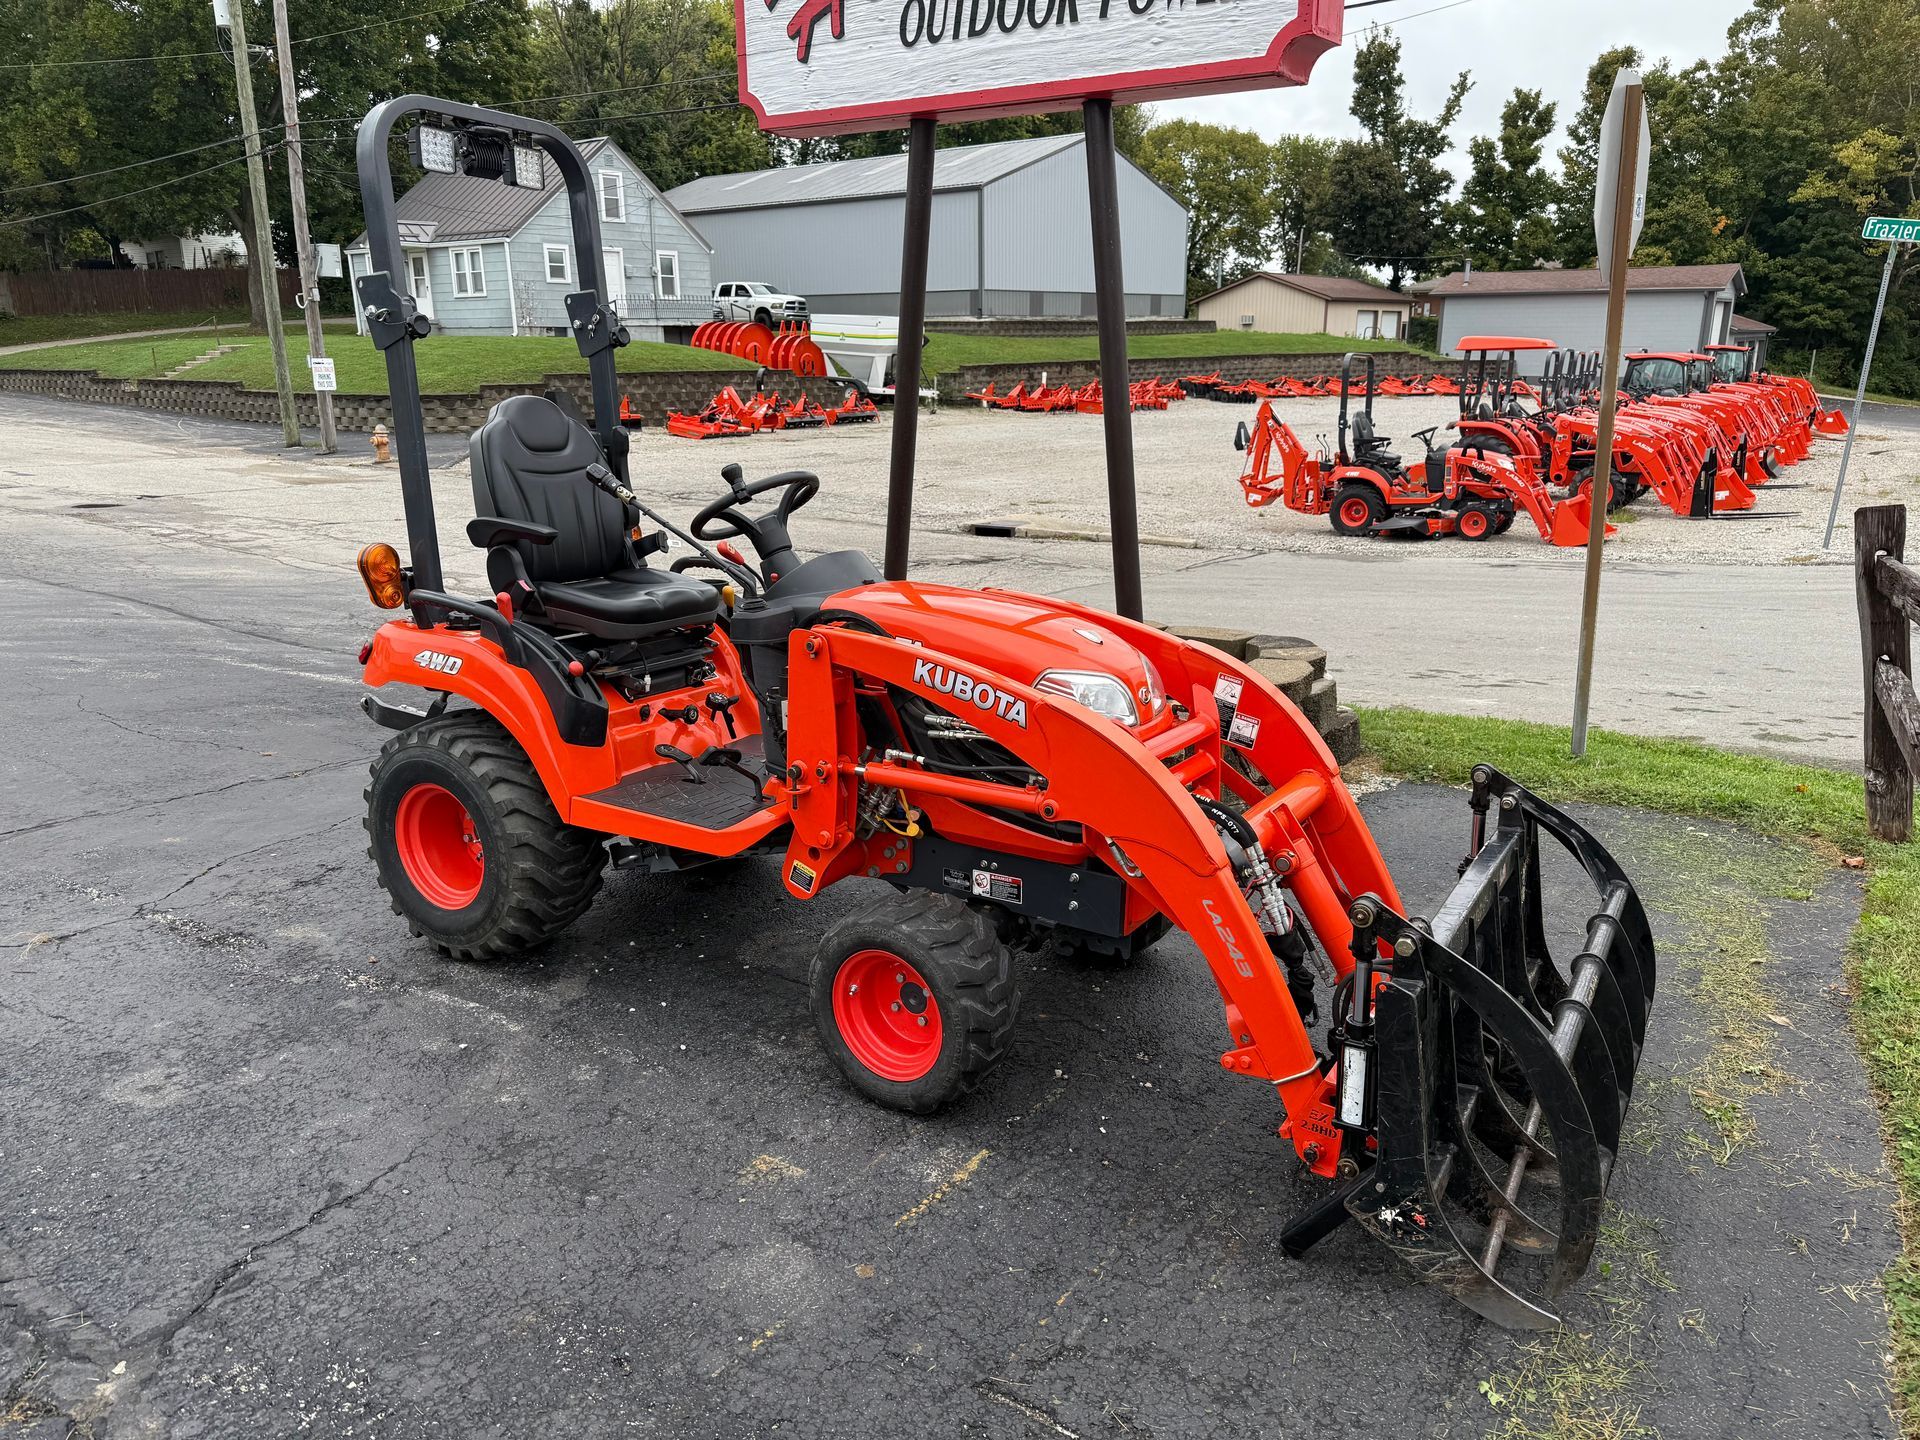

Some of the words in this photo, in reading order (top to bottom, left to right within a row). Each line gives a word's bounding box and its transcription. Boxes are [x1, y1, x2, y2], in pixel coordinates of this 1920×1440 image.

[1865, 219, 1920, 240] Frazier
[413, 649, 464, 676] 4WD
[912, 657, 1028, 730] KUBOTA
[1211, 808, 1240, 834] NPS-077
[1202, 899, 1254, 977] LA243
[1300, 1119, 1338, 1139] 2.8HD
